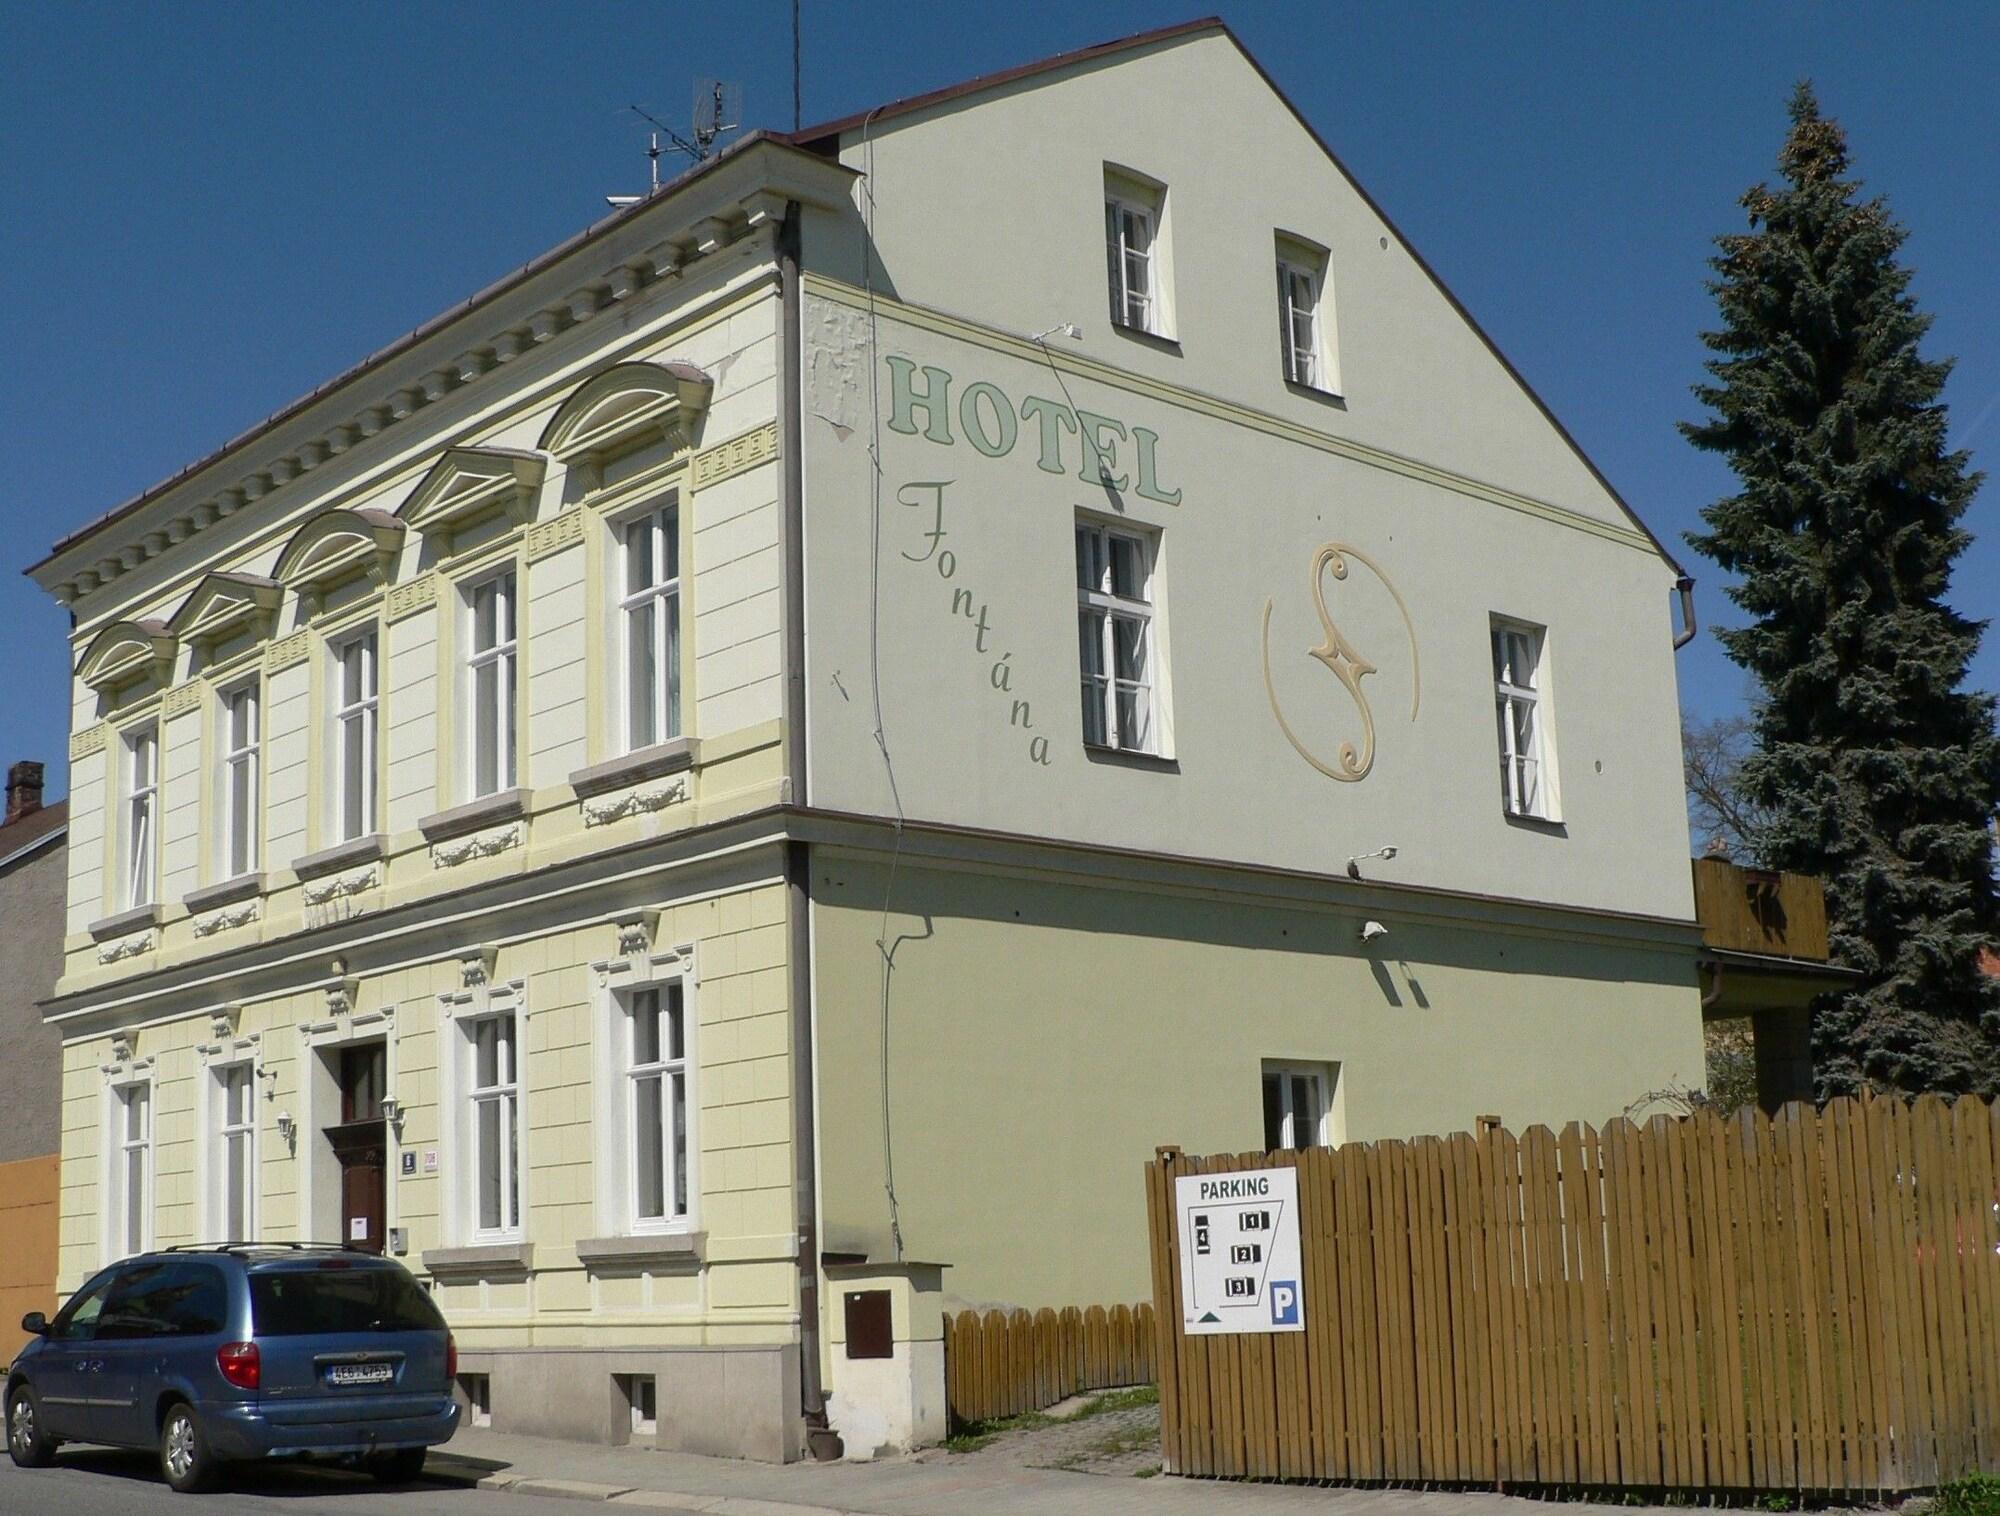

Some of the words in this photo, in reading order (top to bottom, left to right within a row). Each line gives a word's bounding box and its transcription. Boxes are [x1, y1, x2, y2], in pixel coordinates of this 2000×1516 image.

[885, 356, 1182, 507] HOTEL
[898, 479, 1052, 766] Fontána
[1201, 1177, 1269, 1200] PARKING
[1273, 1287, 1294, 1319] P
